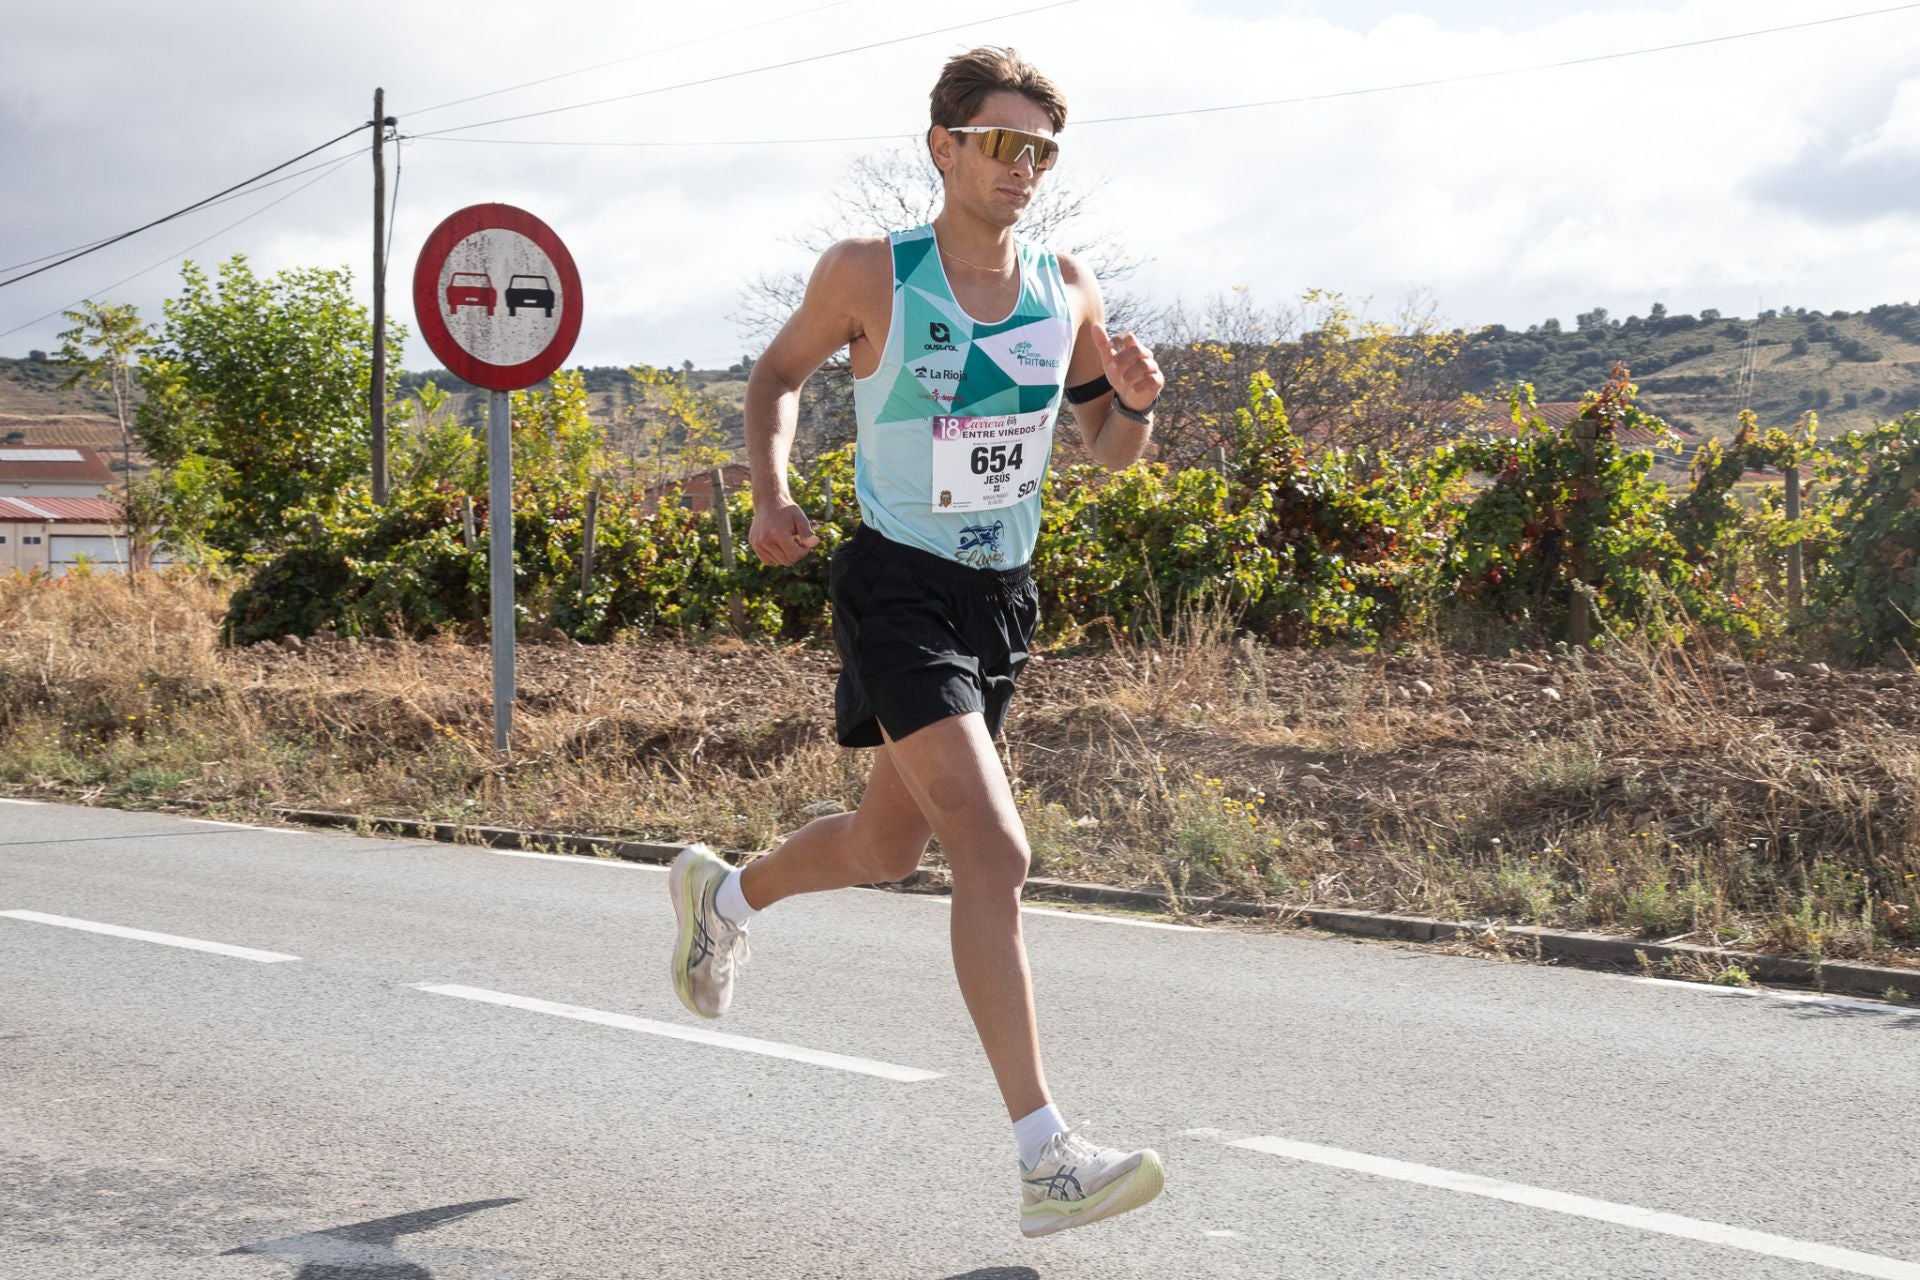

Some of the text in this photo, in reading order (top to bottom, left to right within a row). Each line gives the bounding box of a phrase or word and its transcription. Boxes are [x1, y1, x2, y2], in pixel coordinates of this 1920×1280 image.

[924, 344, 958, 352] austral
[1018, 356, 1060, 368] TRITONES
[930, 369, 968, 382] La Rioja
[940, 418, 961, 440] 18
[961, 417, 1005, 430] Carrera
[962, 425, 1036, 439] ENTRE VIÑEDOS
[970, 443, 1023, 475] 654
[983, 472, 1011, 485] JESÚS
